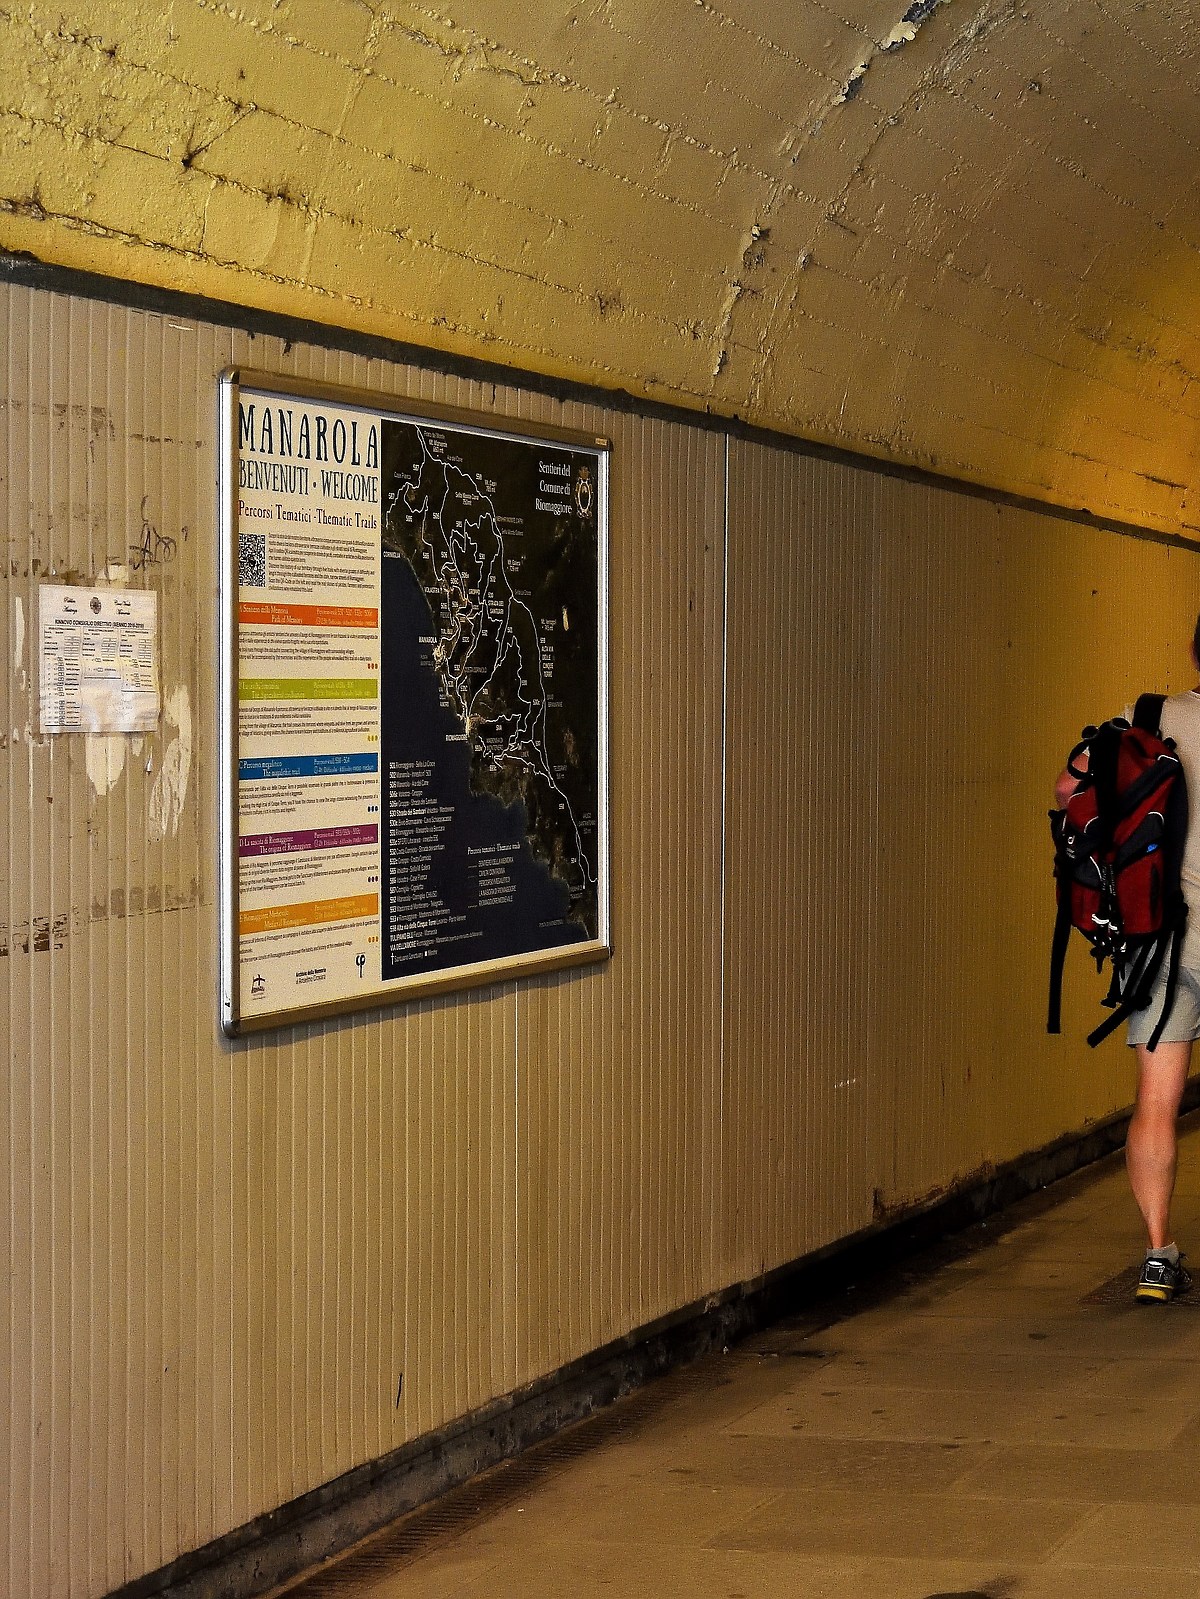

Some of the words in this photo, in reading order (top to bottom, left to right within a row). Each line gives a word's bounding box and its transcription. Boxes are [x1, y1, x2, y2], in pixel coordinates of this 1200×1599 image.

[238, 402, 379, 469] MANAROLA
[539, 460, 561, 475] Sentieri
[562, 464, 570, 477] del
[239, 459, 309, 495] BENVENUTI
[320, 469, 379, 503] WELCOME
[540, 480, 564, 494] Comune
[564, 483, 570, 496] di
[238, 500, 273, 519] Percorsi
[275, 504, 312, 523] Tematici
[355, 512, 378, 530] Trails
[536, 498, 572, 516] Riomaggiore
